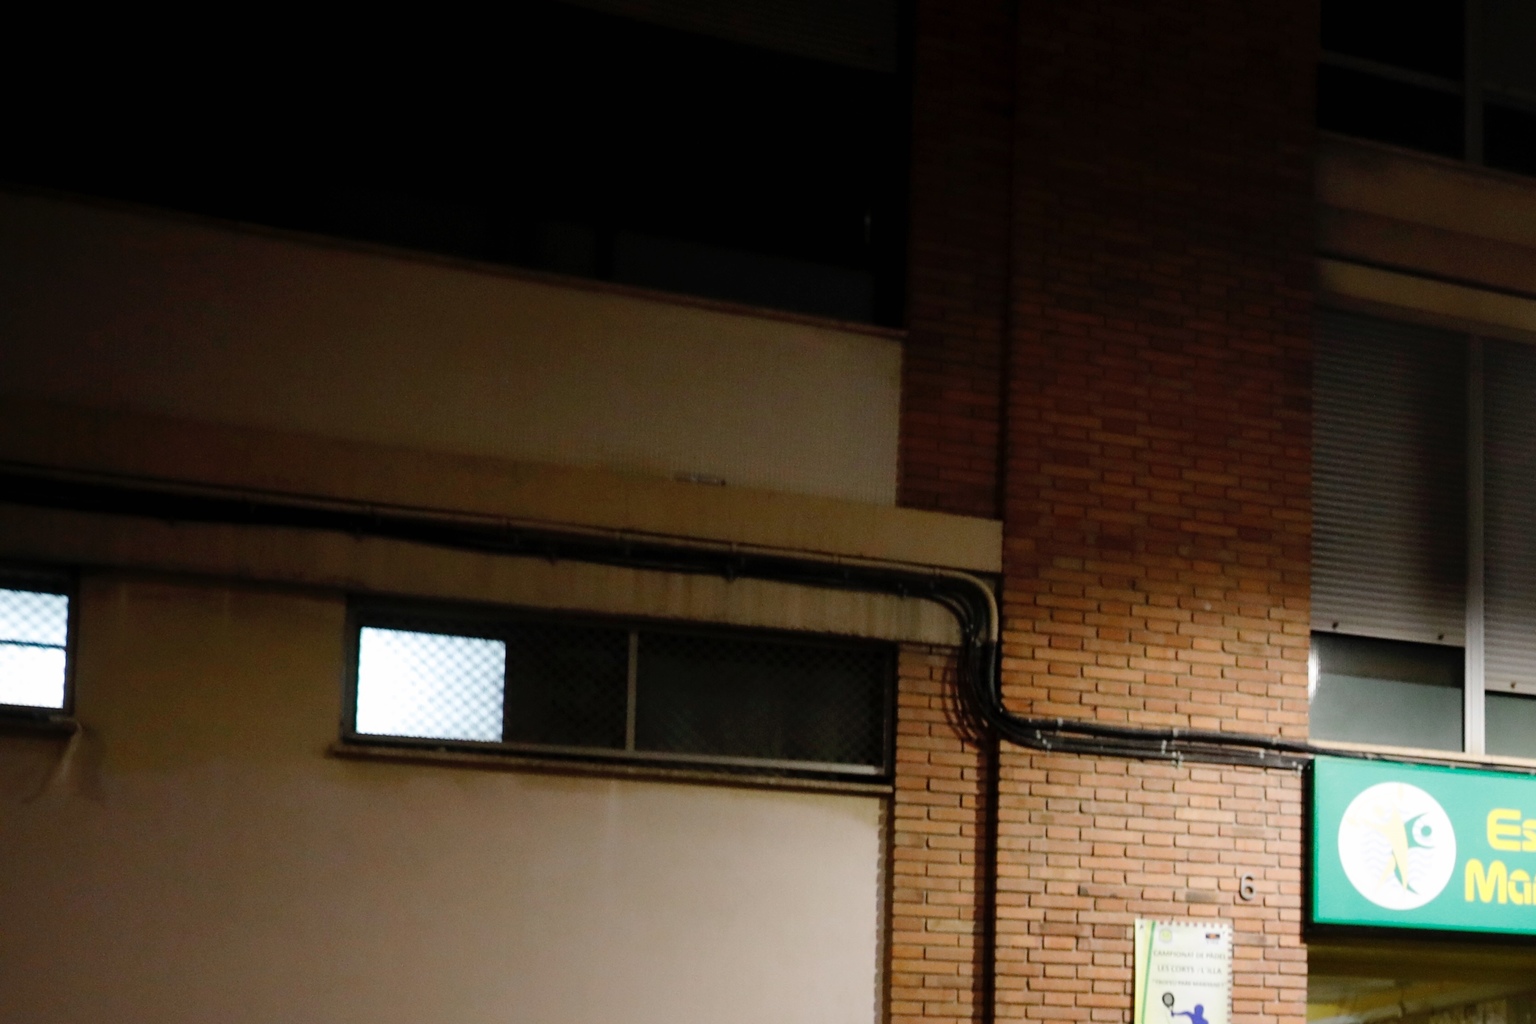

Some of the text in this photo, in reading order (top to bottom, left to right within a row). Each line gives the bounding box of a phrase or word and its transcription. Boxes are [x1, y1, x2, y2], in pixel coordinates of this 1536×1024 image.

[1239, 872, 1257, 901] 6
[1157, 964, 1169, 972] LES
[1171, 965, 1195, 974] CORTS
